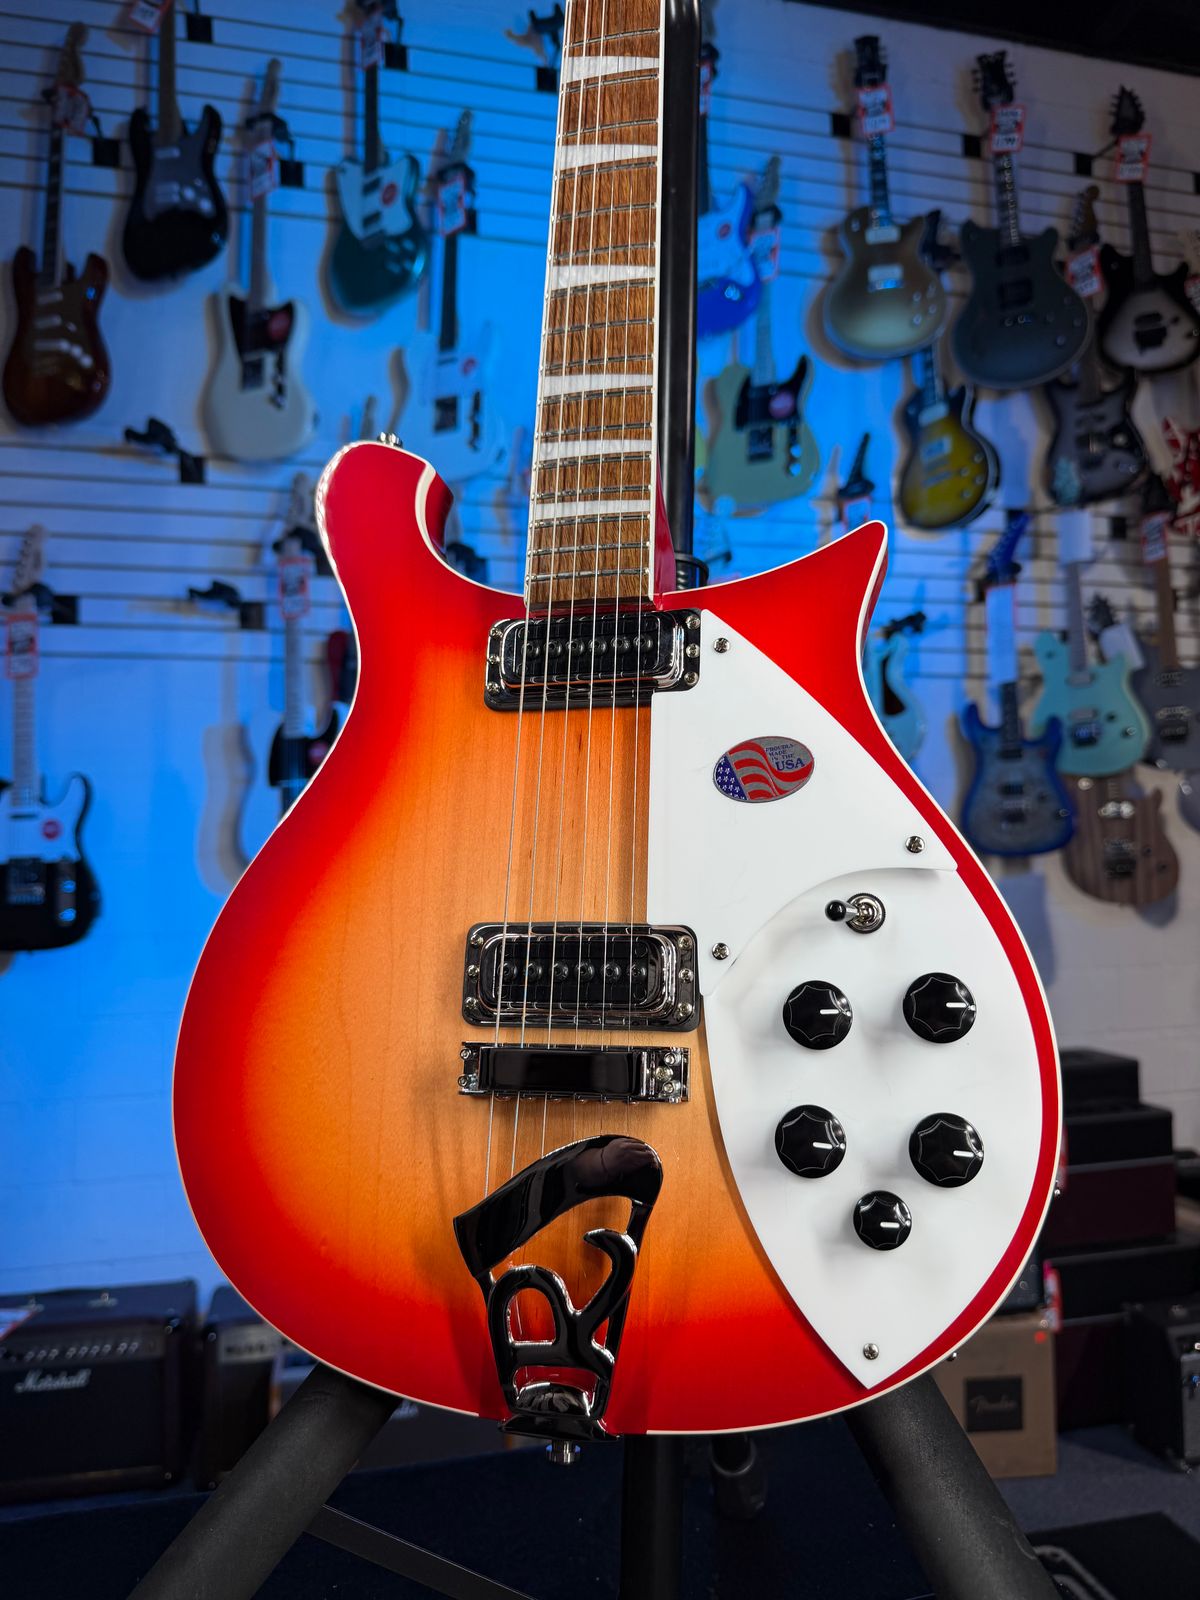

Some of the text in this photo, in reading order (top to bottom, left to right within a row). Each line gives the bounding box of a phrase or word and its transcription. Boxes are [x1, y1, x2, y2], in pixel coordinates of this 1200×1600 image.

[766, 744, 794, 752] PROUDLY
[776, 757, 805, 771] USA
[14, 1368, 91, 1393] Marshall
